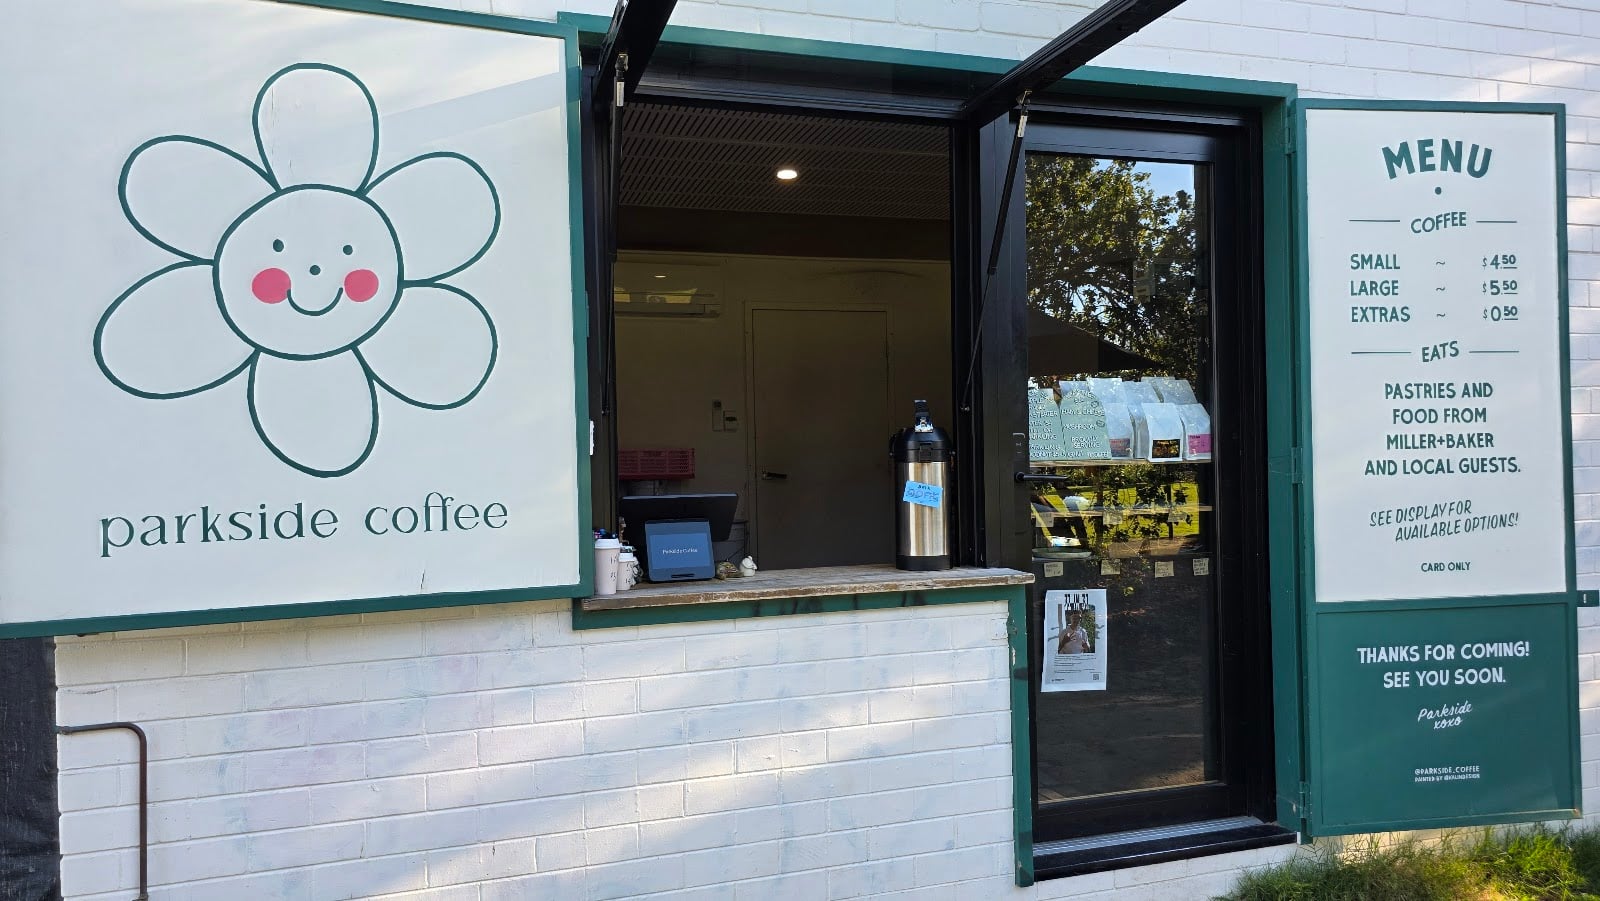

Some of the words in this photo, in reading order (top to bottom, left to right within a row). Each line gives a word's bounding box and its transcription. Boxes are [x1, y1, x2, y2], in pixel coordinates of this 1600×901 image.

[1381, 138, 1493, 180] MENU
[1411, 211, 1467, 234] COFFEE
[1350, 254, 1400, 270] SMALL
[1350, 280, 1399, 296] LARGE
[1351, 306, 1411, 323] EXTRAS
[1422, 340, 1460, 363] EATS
[1385, 383, 1456, 400] PASTRIES
[1461, 382, 1493, 398] AND
[1392, 408, 1438, 424] FOOD
[1443, 407, 1487, 424] FROM
[1386, 432, 1494, 450] MILLER+BAKER
[1364, 459, 1398, 476] AND
[1402, 458, 1455, 475] LOCAL
[1458, 457, 1521, 474] GUESTS.
[1369, 510, 1392, 527] SEE
[1395, 502, 1447, 524] DISPLAY
[1448, 499, 1472, 517] FOR
[99, 502, 339, 558] parkside
[364, 491, 509, 536] coffee
[1395, 519, 1461, 542] AVAILABLE
[1464, 512, 1519, 534] OPTIONS!
[1421, 562, 1445, 572] CARD
[1447, 561, 1471, 571] ONLY
[1356, 645, 1421, 664] THANKS
[1424, 643, 1455, 661] FOR
[1460, 641, 1530, 660] COMING!
[1383, 671, 1410, 689] SEE
[1415, 669, 1450, 687] YOU
[1454, 667, 1506, 685] SOON.
[1417, 700, 1473, 723] Parkside
